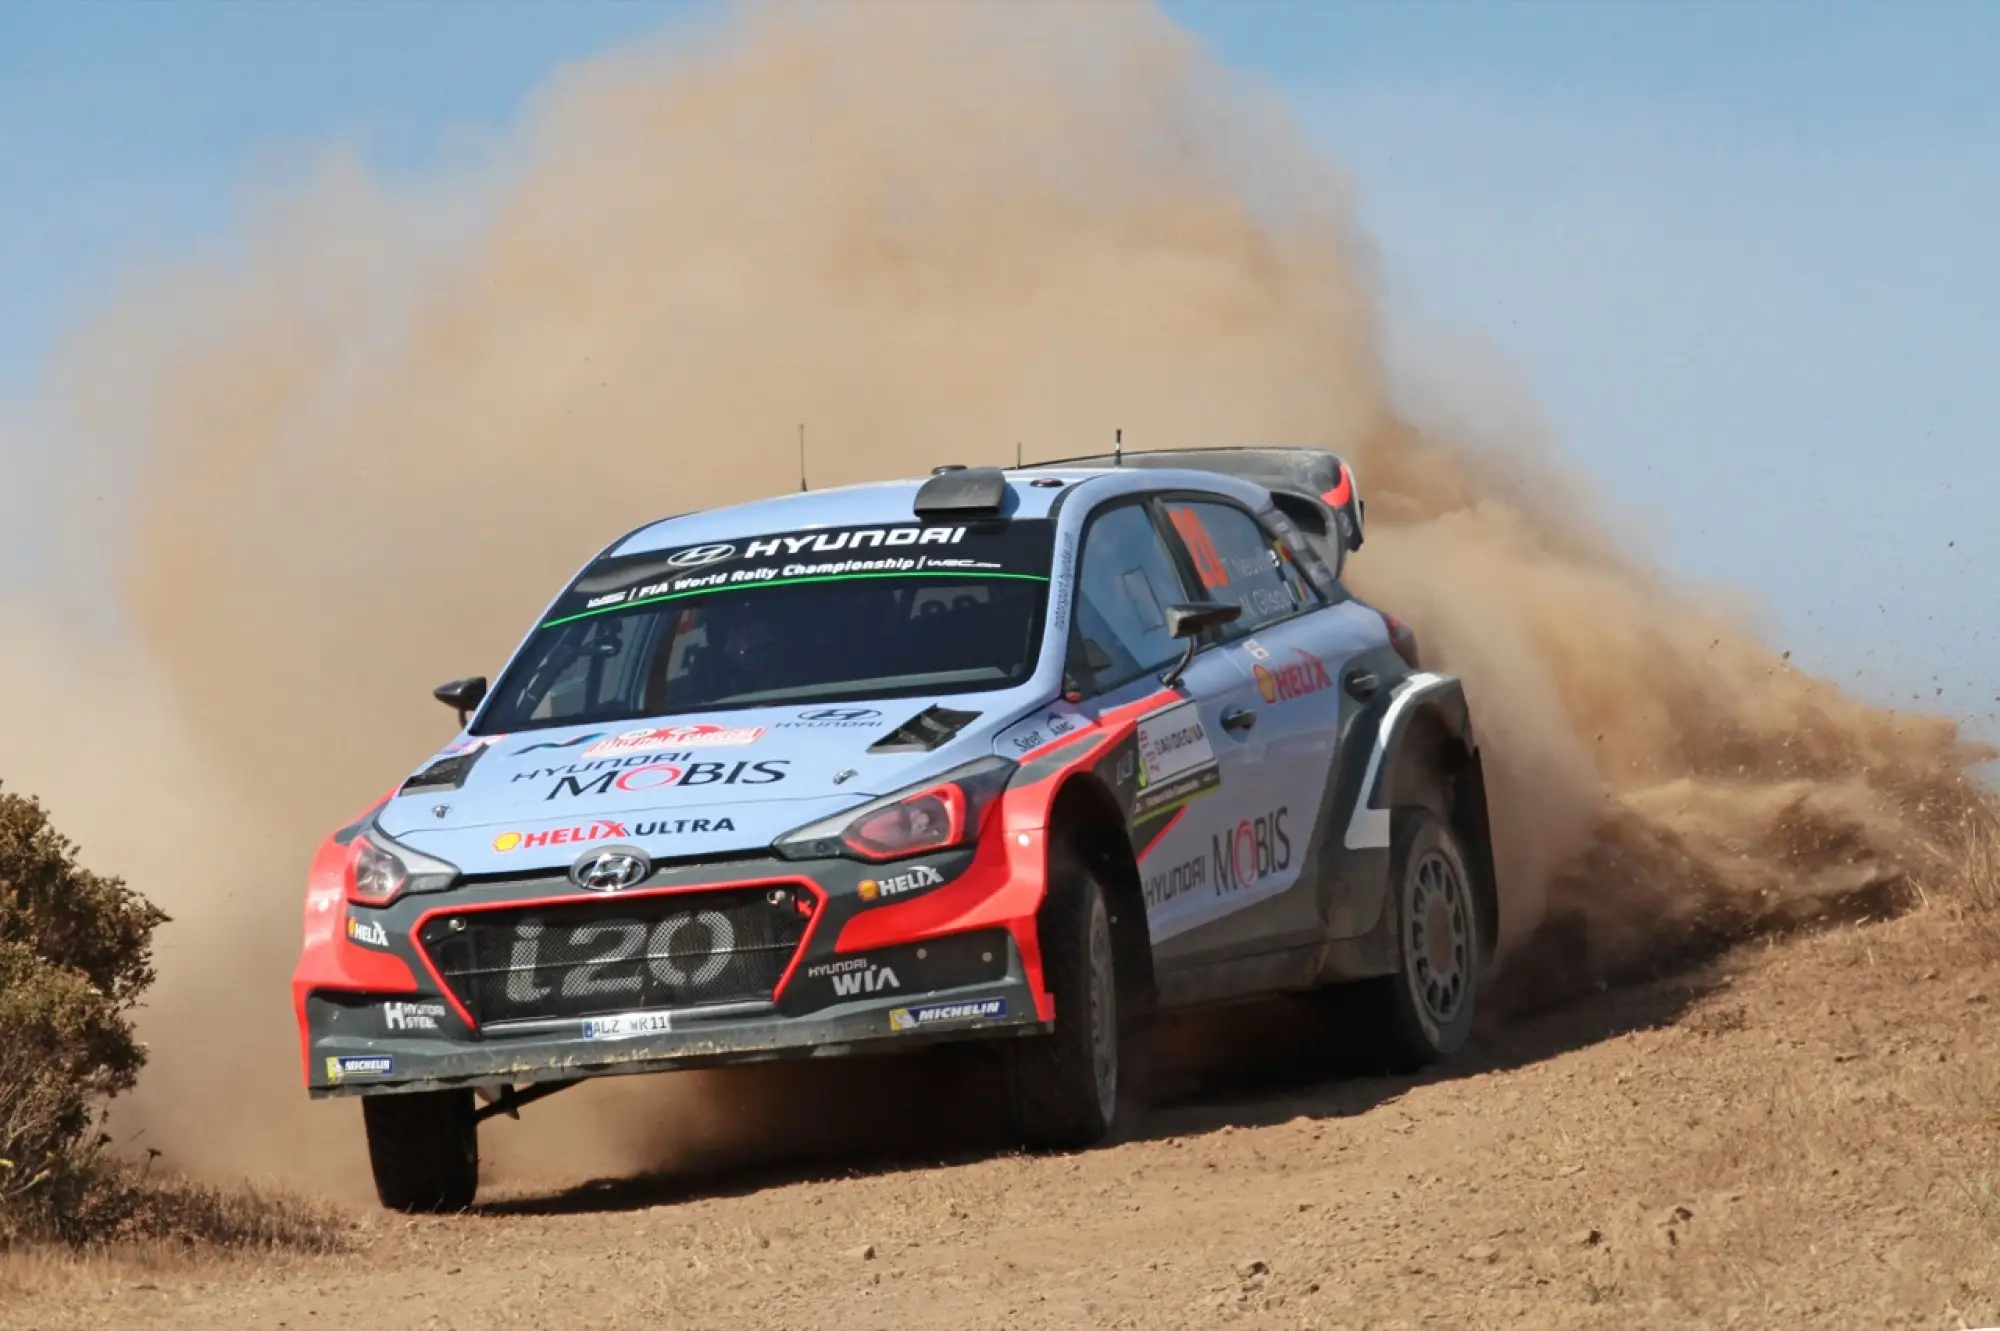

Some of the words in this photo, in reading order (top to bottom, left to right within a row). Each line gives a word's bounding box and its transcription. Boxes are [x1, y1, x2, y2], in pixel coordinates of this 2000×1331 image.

[745, 527, 966, 558] HYUNDAI
[638, 581, 669, 599] FIA
[674, 572, 727, 591] World
[730, 567, 780, 582] Rally
[782, 556, 915, 577] Championship
[1271, 647, 1333, 701] HELIX
[775, 720, 883, 728] HYUNDAI
[511, 751, 693, 783] HYUNDAI
[545, 760, 791, 801] MOBIS
[523, 819, 627, 849] HELIX
[635, 817, 736, 837] ULTRA
[1145, 855, 1206, 907] HYUNDAI
[1212, 806, 1292, 897] MOBIS
[878, 864, 945, 897] HELIX
[354, 920, 390, 948] HELIX
[507, 910, 735, 1002] i20
[808, 958, 868, 978] HYUNDAI
[593, 1019, 621, 1034] ALZ
[918, 1001, 1000, 1022] MICHELIN
[344, 1058, 391, 1072] MICHELIN
